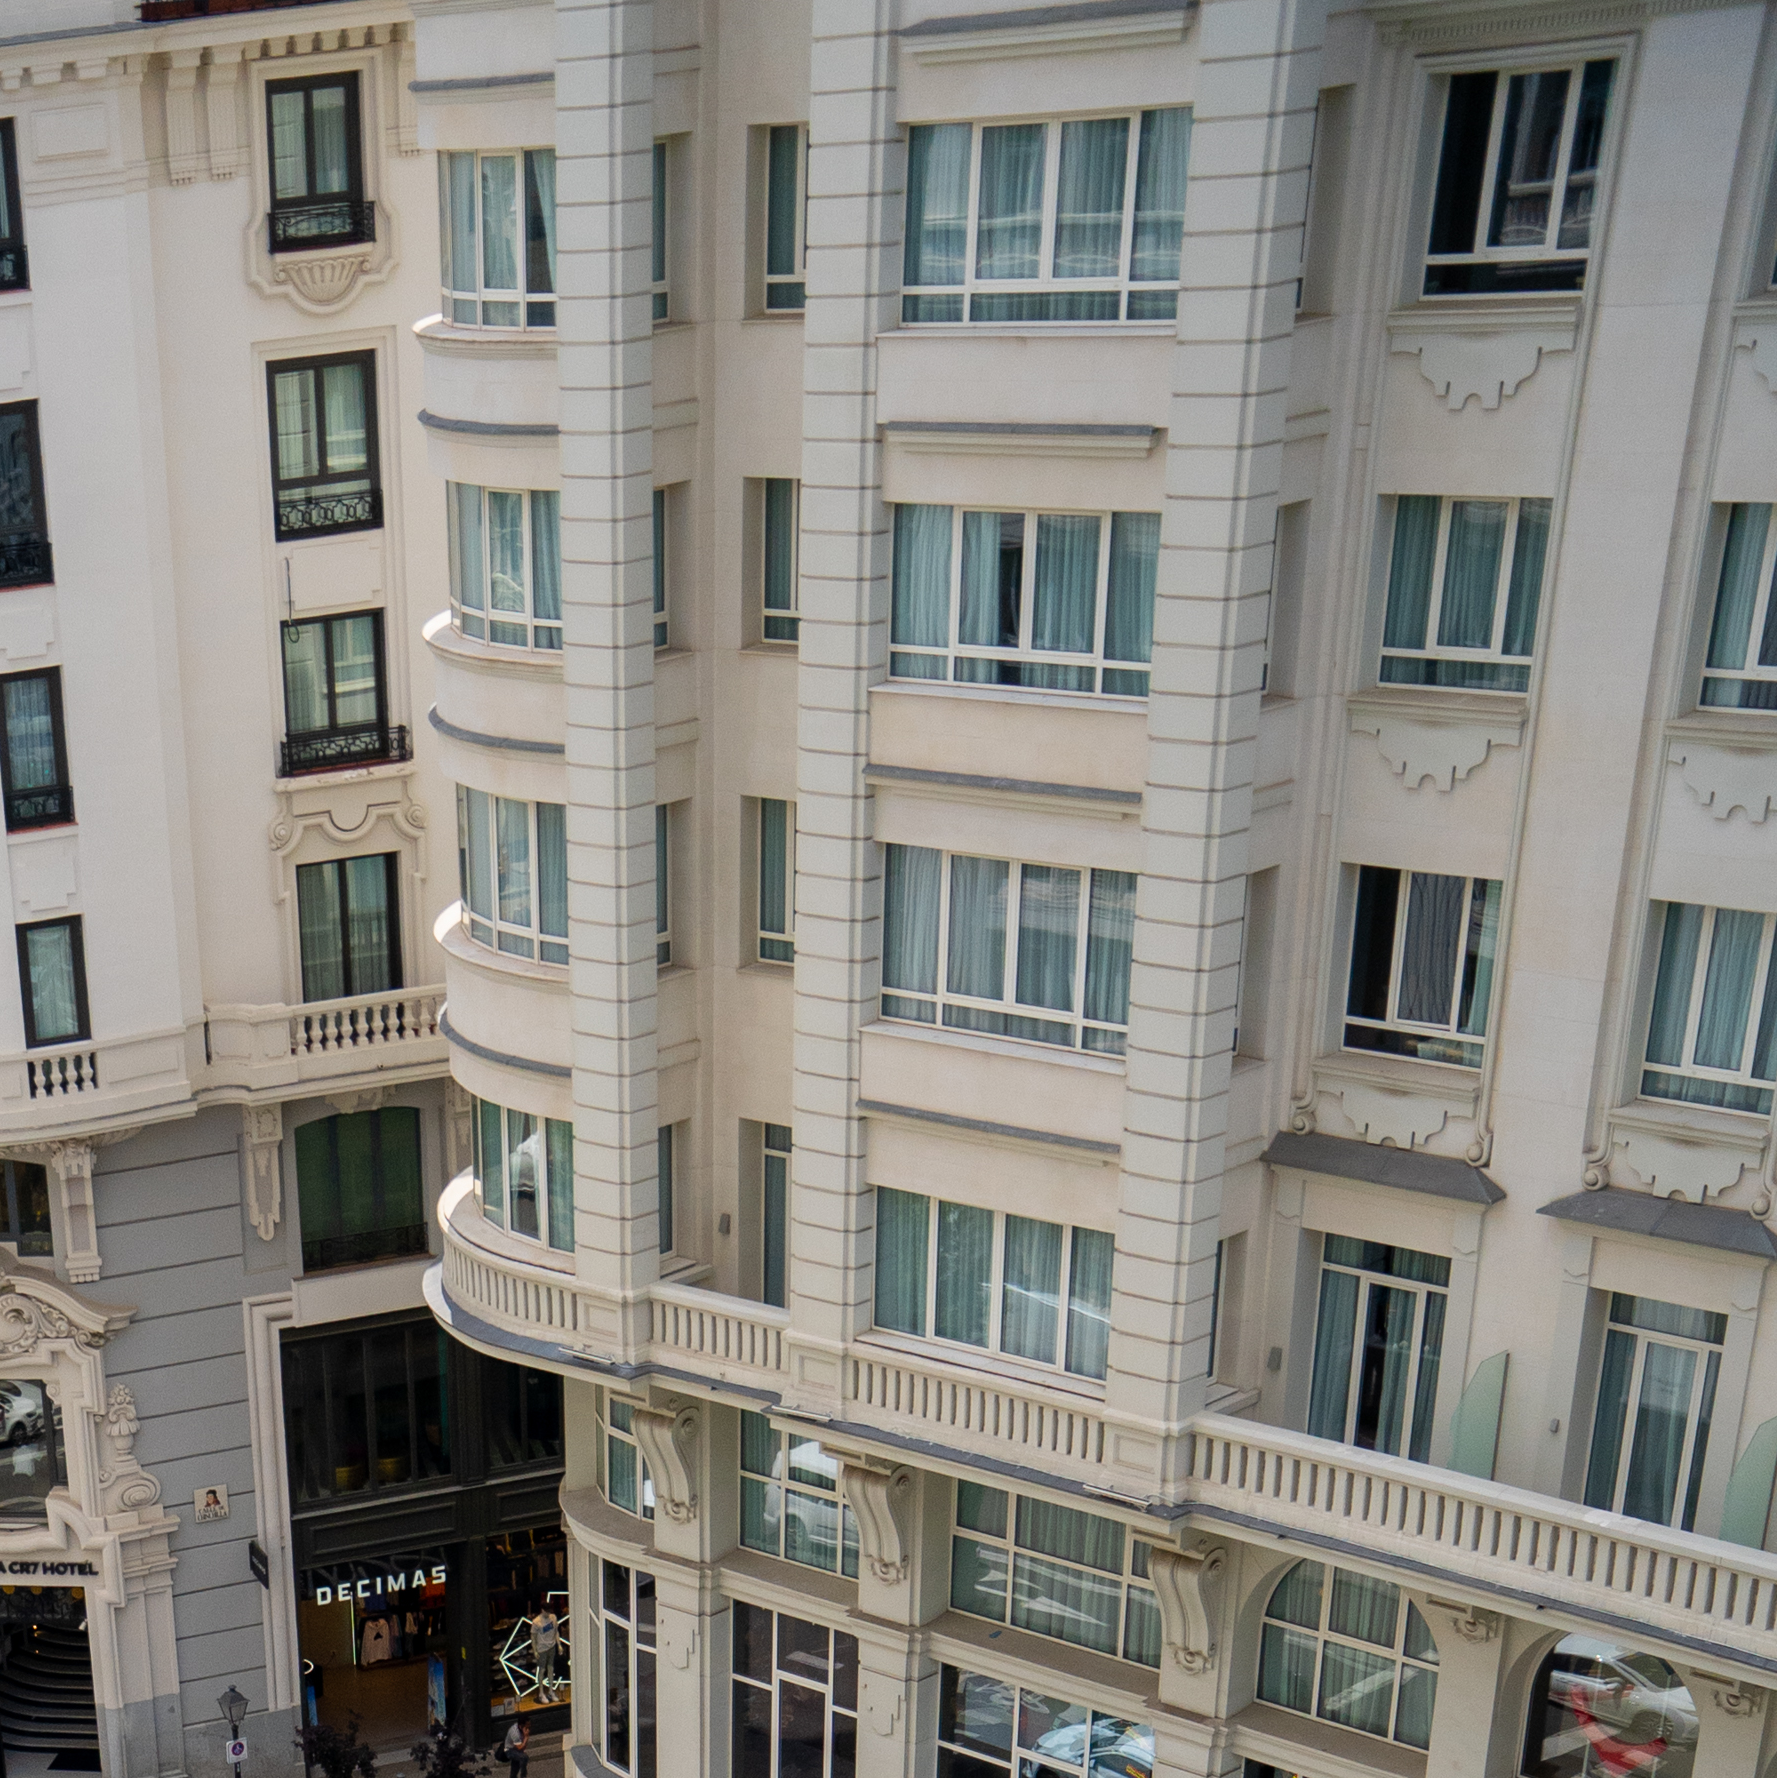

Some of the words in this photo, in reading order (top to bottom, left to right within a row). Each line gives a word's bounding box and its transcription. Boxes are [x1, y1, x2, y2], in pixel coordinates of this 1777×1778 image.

[8, 1561, 41, 1575] CR7
[42, 1561, 99, 1576] HOTEL
[316, 1565, 446, 1606] DECIMAS
